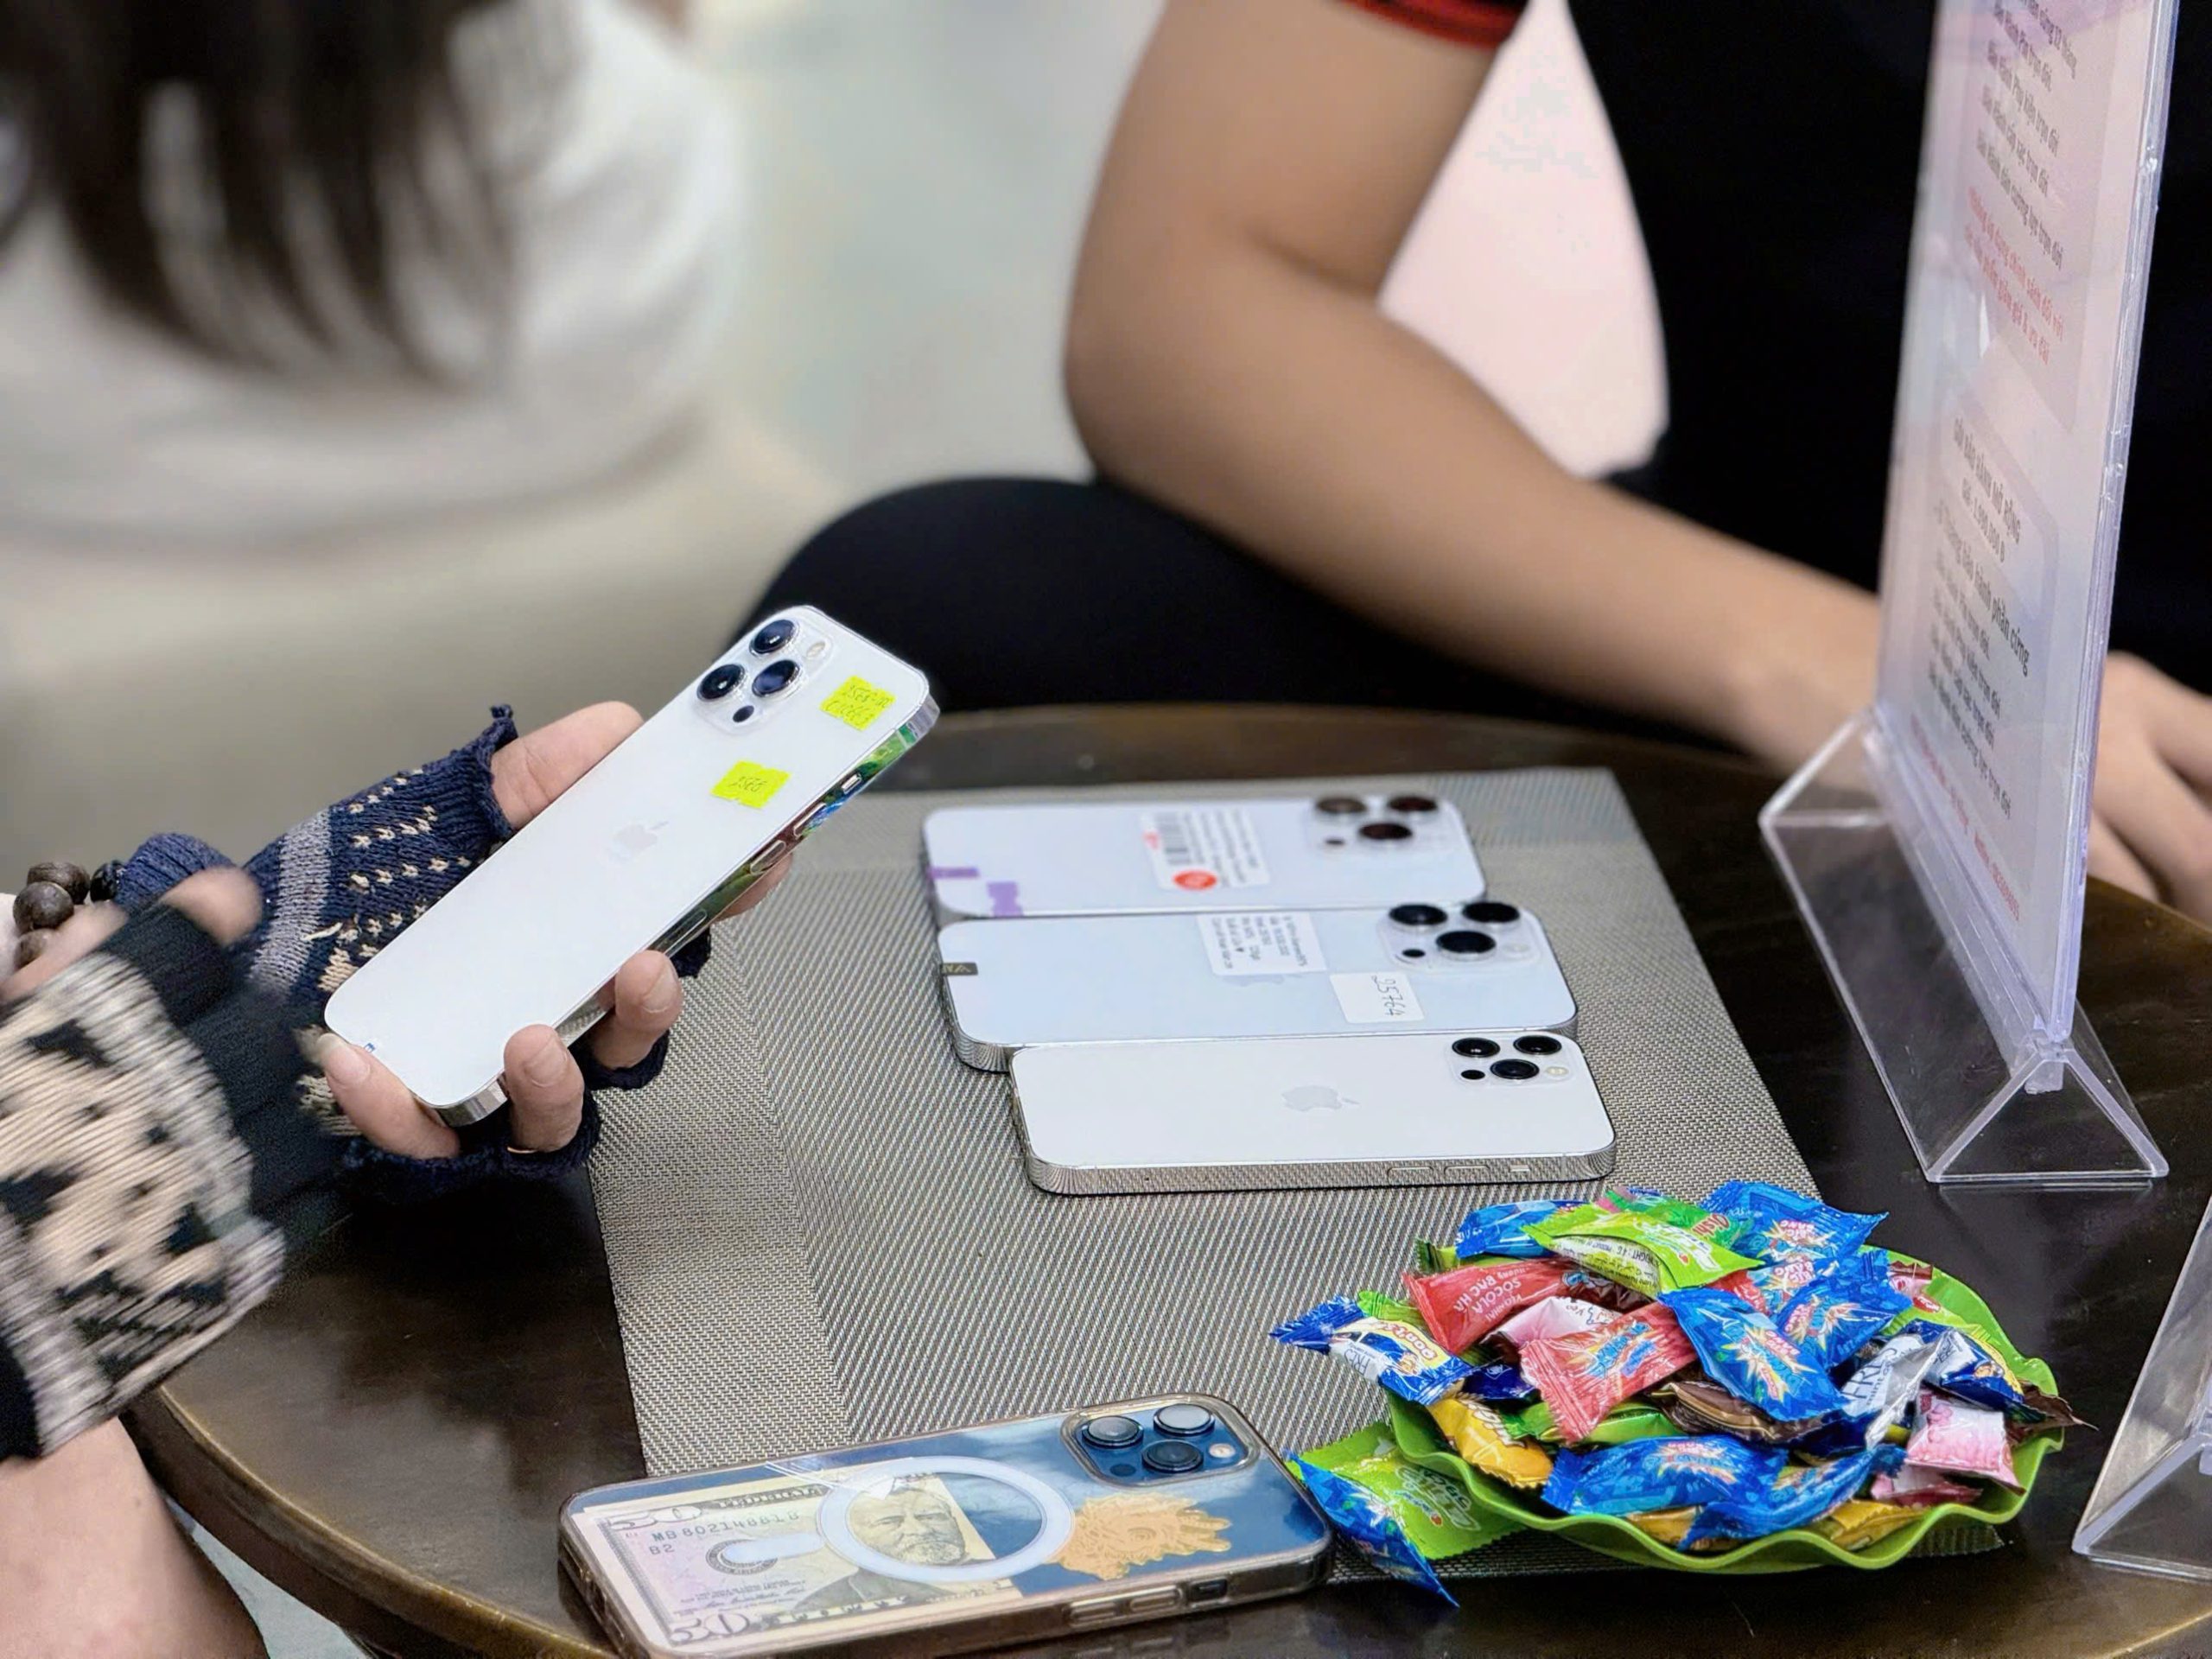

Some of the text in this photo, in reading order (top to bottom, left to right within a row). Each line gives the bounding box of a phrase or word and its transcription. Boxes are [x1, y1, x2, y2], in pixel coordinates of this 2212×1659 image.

[1992, 597, 2009, 640] phần
[2010, 627, 2030, 677] cứng
[1693, 1213, 1730, 1237] Oishi
[652, 1530, 678, 1542] MB
[649, 1544, 676, 1556] B2
[670, 1612, 750, 1643] 50
